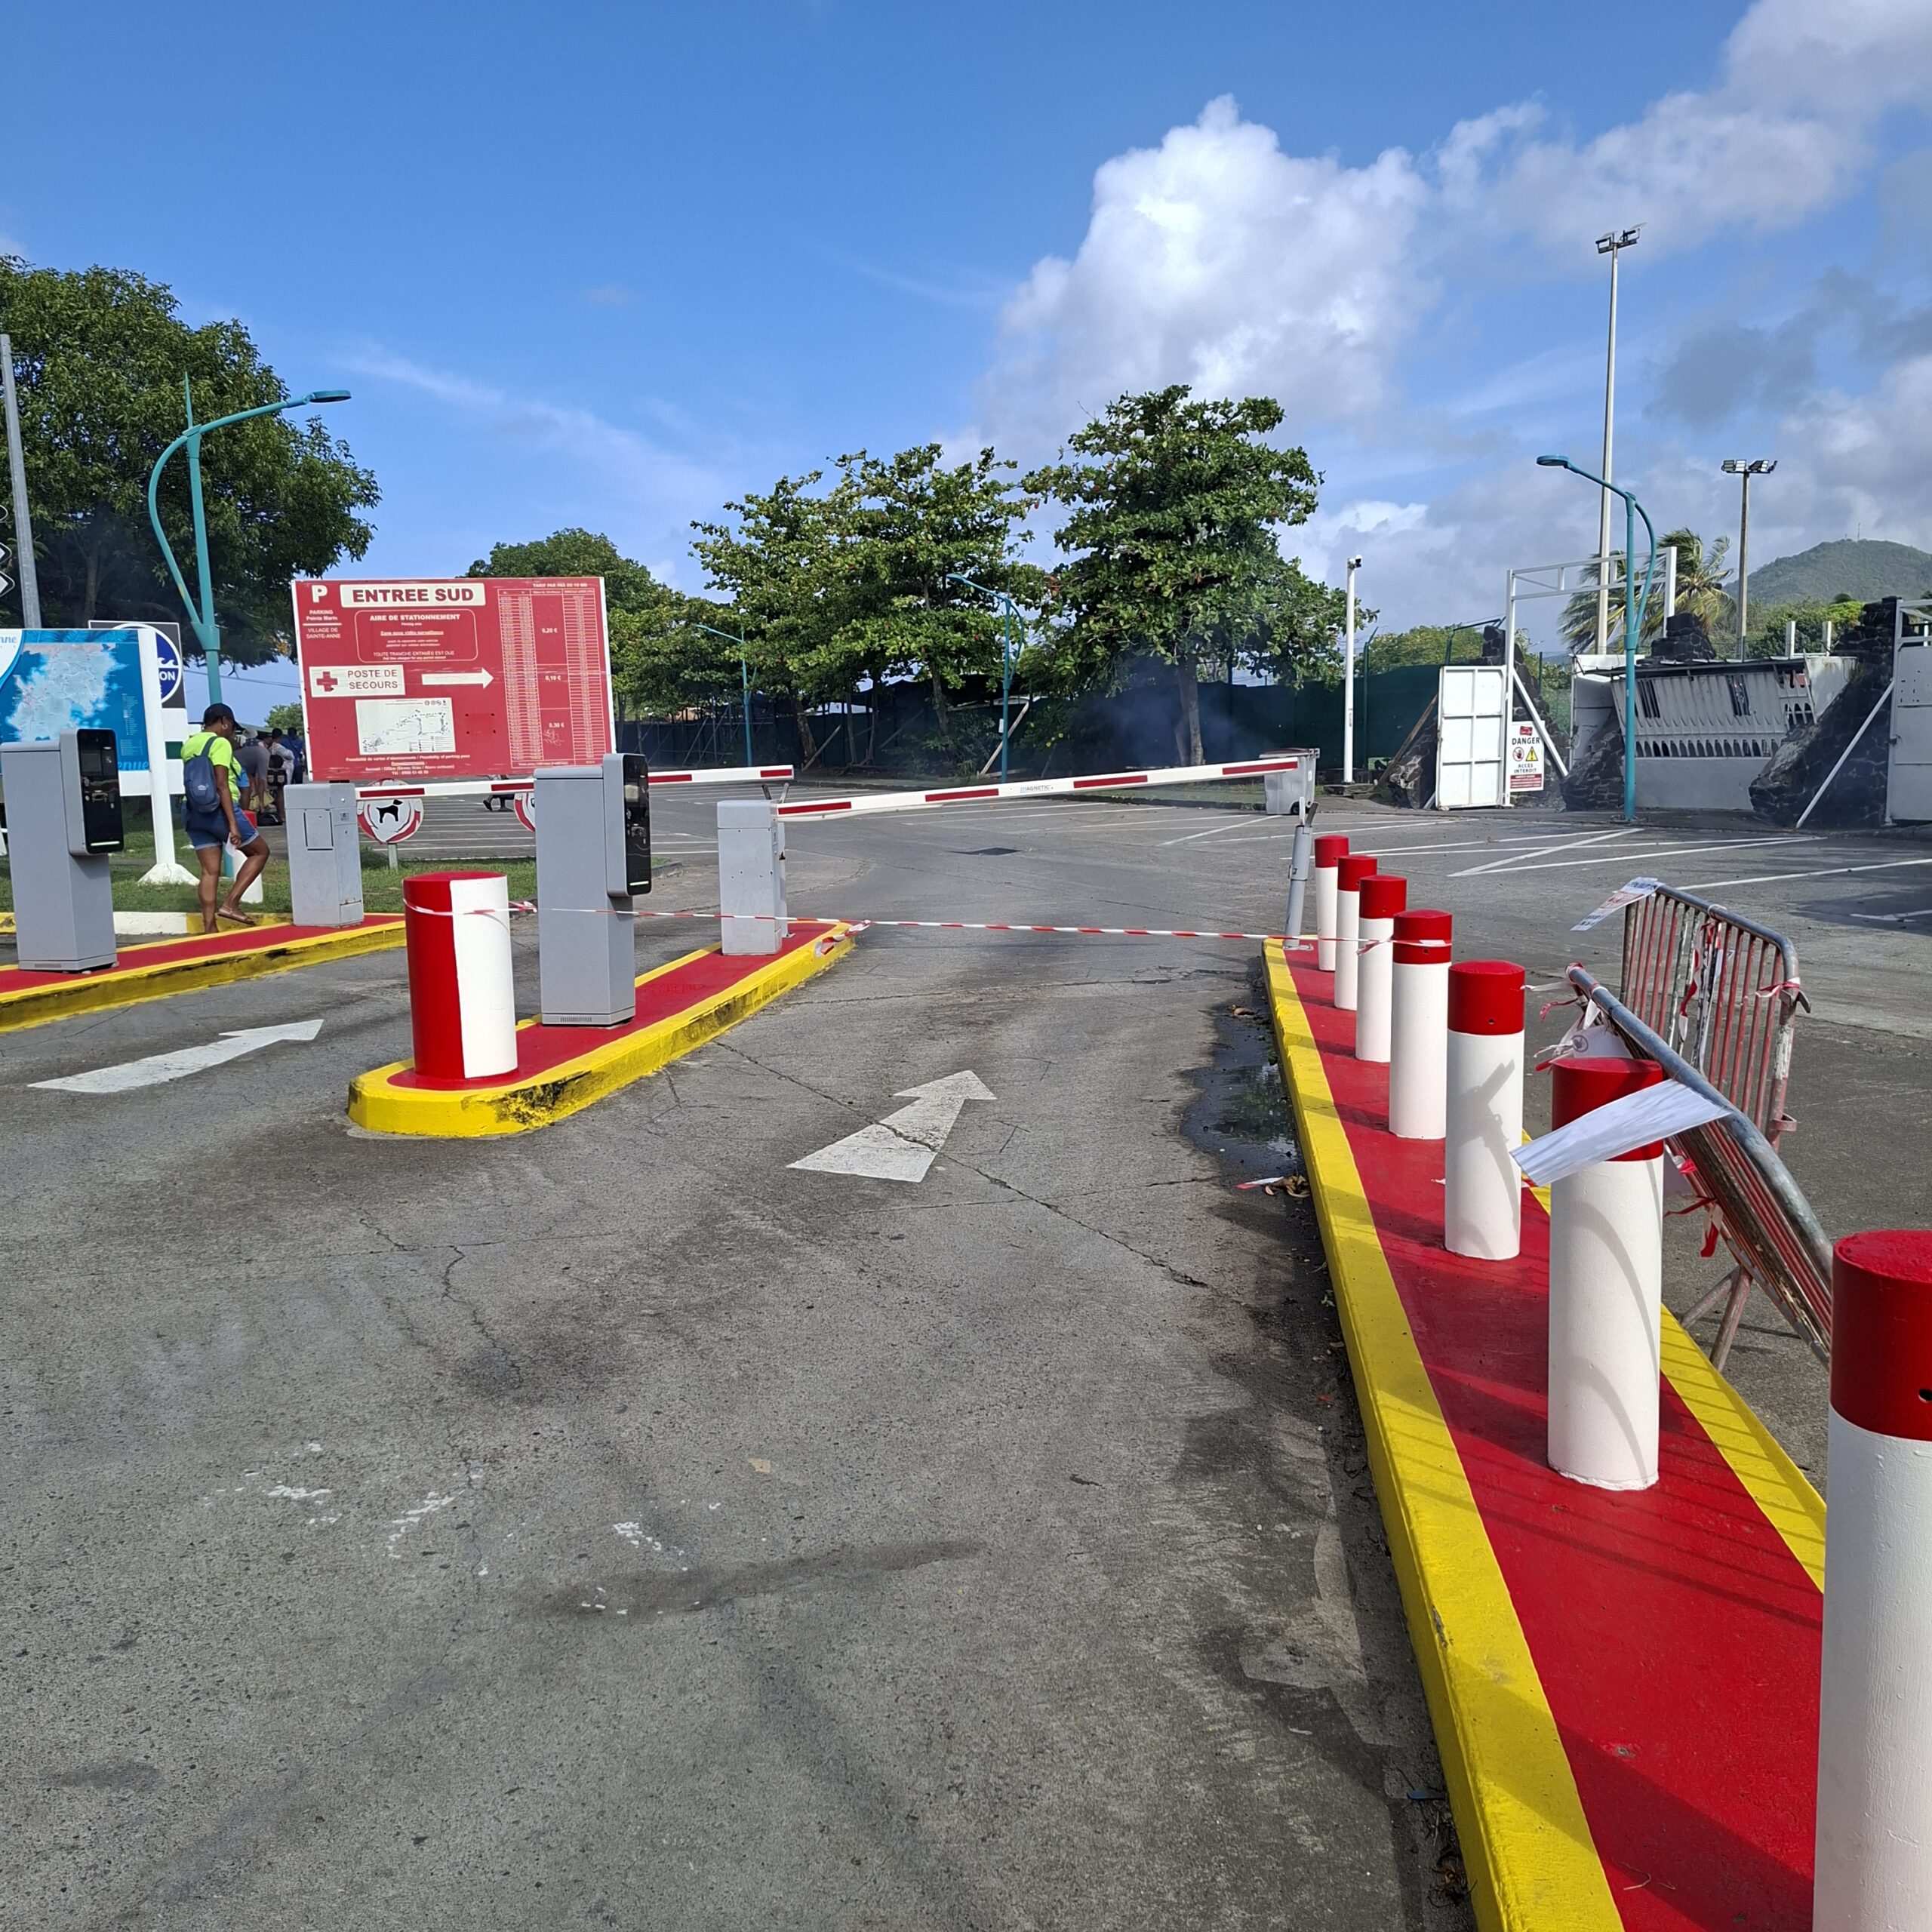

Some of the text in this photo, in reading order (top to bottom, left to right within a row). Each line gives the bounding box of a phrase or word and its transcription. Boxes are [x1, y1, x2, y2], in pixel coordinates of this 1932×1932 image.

[311, 585, 328, 603] P
[352, 588, 474, 603] ENTREE SUD
[347, 669, 381, 678] POSTE
[349, 681, 398, 690] SECOURS
